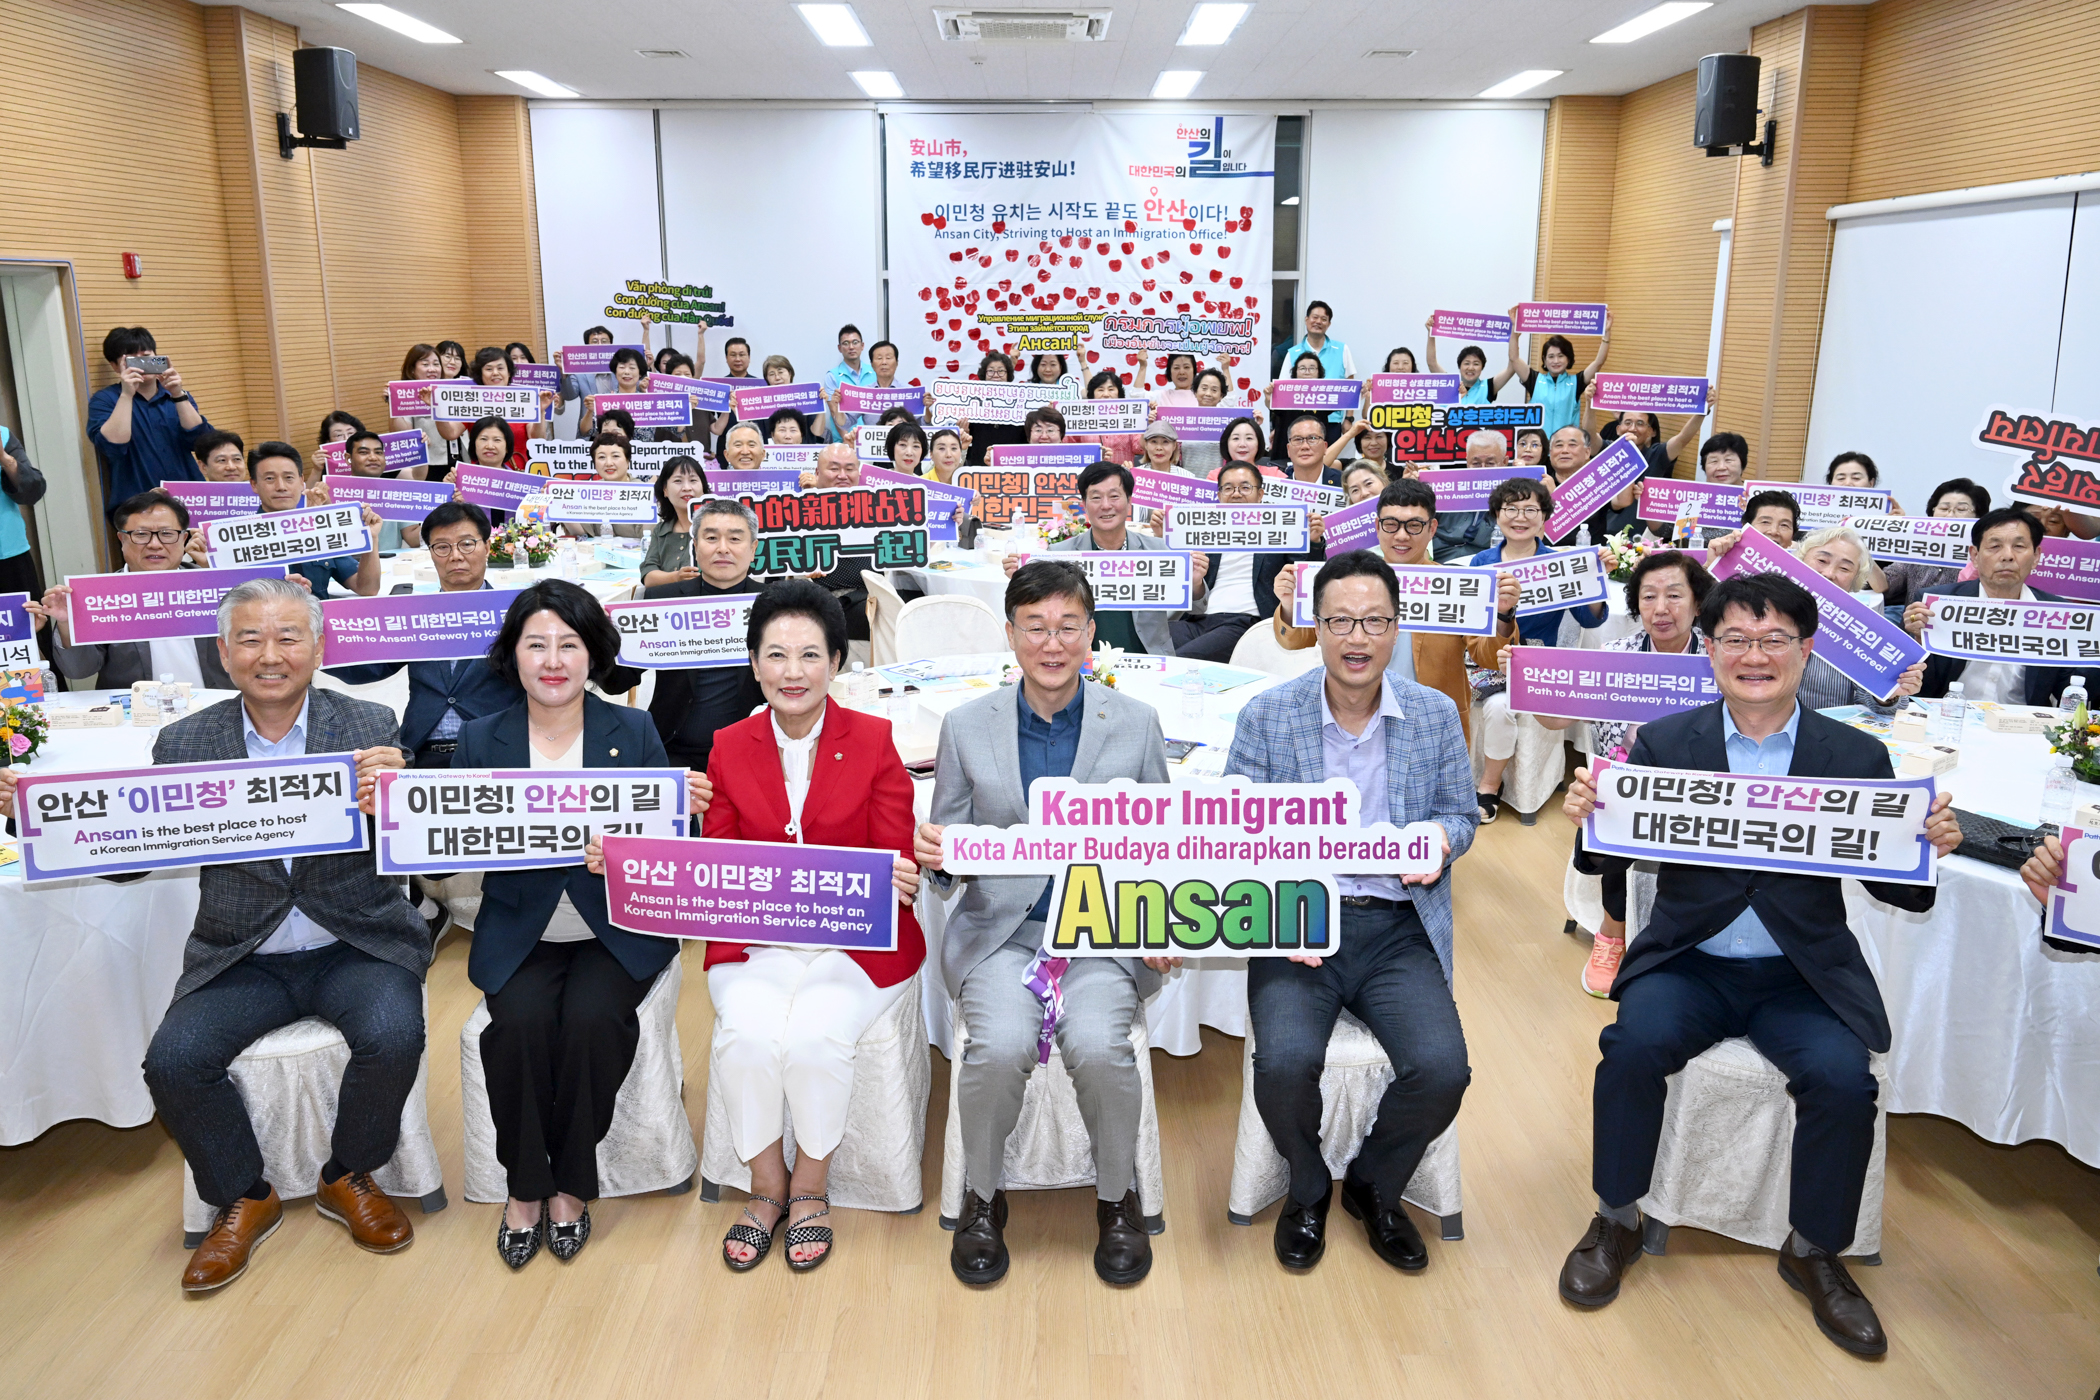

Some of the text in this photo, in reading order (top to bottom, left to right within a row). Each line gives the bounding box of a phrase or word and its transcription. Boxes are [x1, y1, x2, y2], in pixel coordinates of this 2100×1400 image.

[1177, 128, 1210, 140] 안산의
[910, 139, 968, 157] 安山市,
[910, 160, 1075, 179] 希望移民厅进驻安山!
[1129, 165, 1186, 178] 대한민국의
[935, 199, 1228, 222] 이민청 유치는 시작도 끝도 안산이다!
[935, 229, 970, 238] Ansan
[973, 229, 999, 241] City,
[1002, 228, 1048, 240] Striving
[1051, 228, 1062, 237] to
[1066, 228, 1092, 237] Host
[1114, 228, 1185, 241] Immigration
[1189, 229, 1227, 239] Office!
[648, 282, 680, 296] phòng
[693, 286, 712, 298] trú!
[615, 294, 635, 305] Con
[671, 299, 689, 309] của
[691, 300, 725, 313] Ansan!
[605, 307, 626, 318] Con
[662, 312, 680, 322] của
[682, 313, 700, 323] Hàn
[978, 313, 1083, 324] Управление миграционной
[1523, 309, 1540, 317] 안산
[1574, 310, 1598, 319] 최적지
[1008, 324, 1089, 333] Этим займётся город
[1019, 335, 1078, 350] Ансан!
[844, 390, 920, 400] 이민청은 상호문화도시
[1294, 394, 1338, 404] 안산으로
[1393, 389, 1437, 400] 안산으로
[448, 406, 525, 417] 대한민국의 길!
[602, 401, 619, 410] 안산
[657, 400, 683, 409] 최적지
[1372, 406, 1540, 427] 이민청은 상호문화도시
[390, 439, 418, 451] 최적지
[554, 460, 586, 470] to the
[1000, 455, 1094, 464] 안산의 길! 대한민국의 길!
[1597, 449, 1629, 477] 최적지
[733, 482, 780, 491] 대한민국의
[783, 482, 794, 490] 길!
[1177, 512, 1296, 525] 이민청! 안산의 길
[1686, 504, 1692, 515] 2
[218, 522, 276, 542] 이민청!
[280, 516, 332, 534] 안산의
[336, 511, 353, 526] 길
[1854, 517, 1966, 538] 이민청! 안산의
[1186, 532, 1287, 545] 대한민국의 길!
[234, 533, 348, 563] 대한민국의 길!
[1100, 560, 1175, 577] 안산의 길
[1559, 581, 1583, 598] 길!
[92, 609, 218, 623] Path to Ansan! Gatewa
[329, 610, 495, 631] 안산의 길! 대한민국의
[618, 609, 735, 633] 안산 ‘이민청’
[1438, 604, 1466, 624] 길!
[1941, 605, 2094, 631] 이민청! 안산의
[1878, 643, 1905, 665] 길!
[1527, 687, 1552, 696] Path
[1555, 689, 1565, 697] to
[1569, 690, 1607, 700] Ansan!
[1610, 693, 1662, 705] Gateway
[1665, 697, 1676, 705] to
[37, 772, 342, 823] 안산 ‘이민청’ 최적지
[408, 784, 660, 815] 이민청! 안산의 길
[1616, 775, 1909, 818] 이민청! 안산의 길
[1041, 789, 1347, 834] Kantor Imigrant
[74, 813, 307, 844] Ansan is the best place to host
[1632, 812, 1880, 862] 대한민국의 길!
[90, 828, 295, 855] a Korean Immigration Service Agency
[427, 826, 591, 856] 대한민국의
[953, 835, 1429, 866] Kota Antar Budaya diharapkan berada di
[622, 860, 870, 898] 안산 ‘이민청’ 최적지
[630, 892, 865, 917] Ansan is the best place to host an
[1052, 864, 1329, 950] Ansan
[624, 904, 873, 934] Korean Immigration Service Agency
